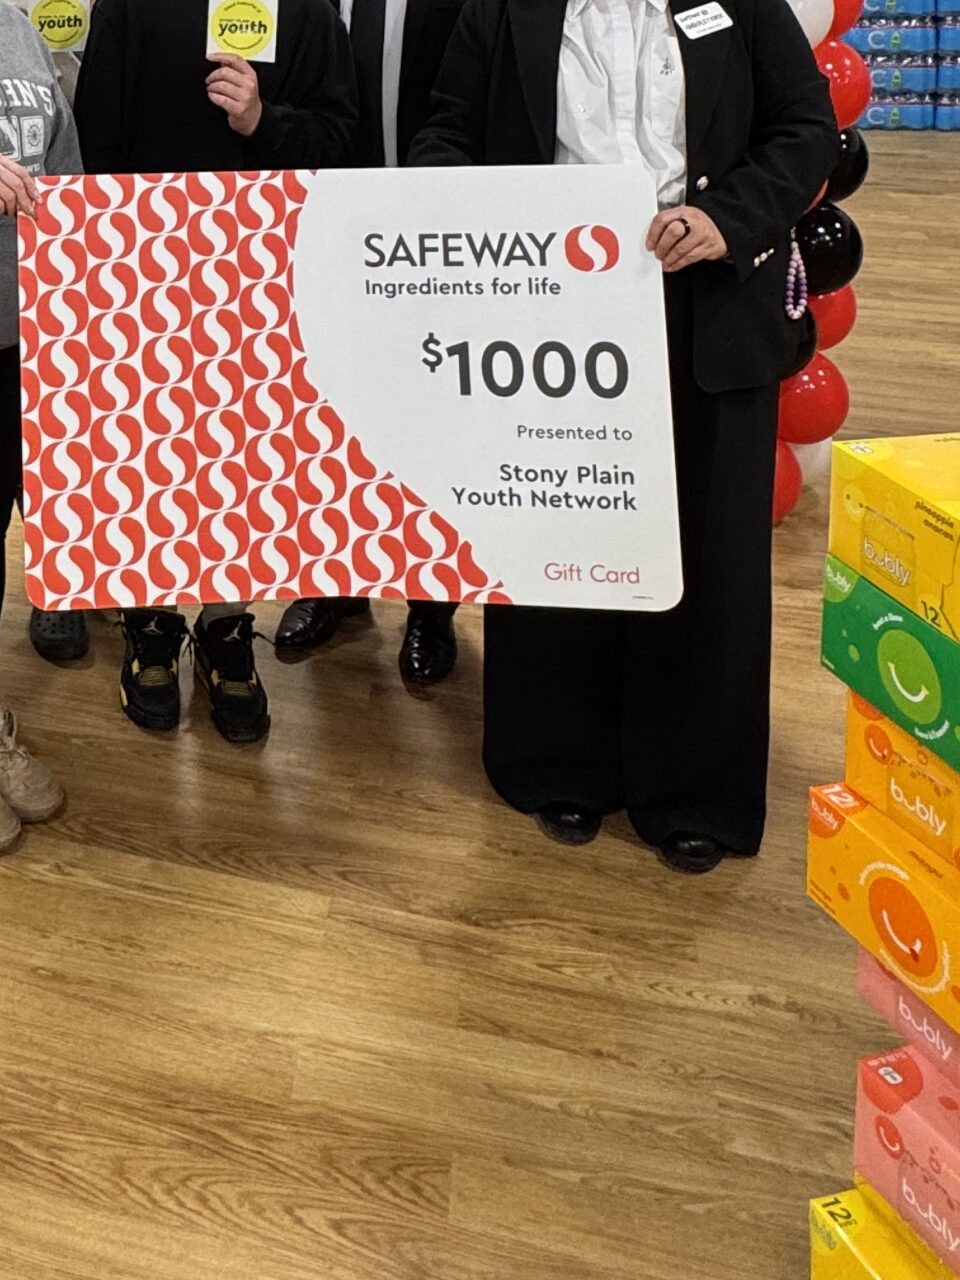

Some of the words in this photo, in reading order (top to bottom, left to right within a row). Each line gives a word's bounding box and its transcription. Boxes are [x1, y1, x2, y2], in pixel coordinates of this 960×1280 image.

[38, 15, 82, 32] youth
[218, 21, 268, 36] youth
[364, 232, 557, 268] SAFEWAY
[365, 278, 484, 299] Ingredients
[491, 277, 521, 295] for
[528, 277, 561, 295] life
[421, 331, 629, 399] $1000
[517, 425, 607, 441] Presented
[613, 427, 633, 441] to
[499, 464, 568, 487] Stony
[577, 464, 635, 485] Plain
[451, 487, 522, 507] Youth
[531, 489, 637, 511] Network
[544, 562, 582, 582] Gift
[590, 564, 640, 584] Card
[921, 599, 942, 628] 12
[822, 1196, 852, 1224] 12
